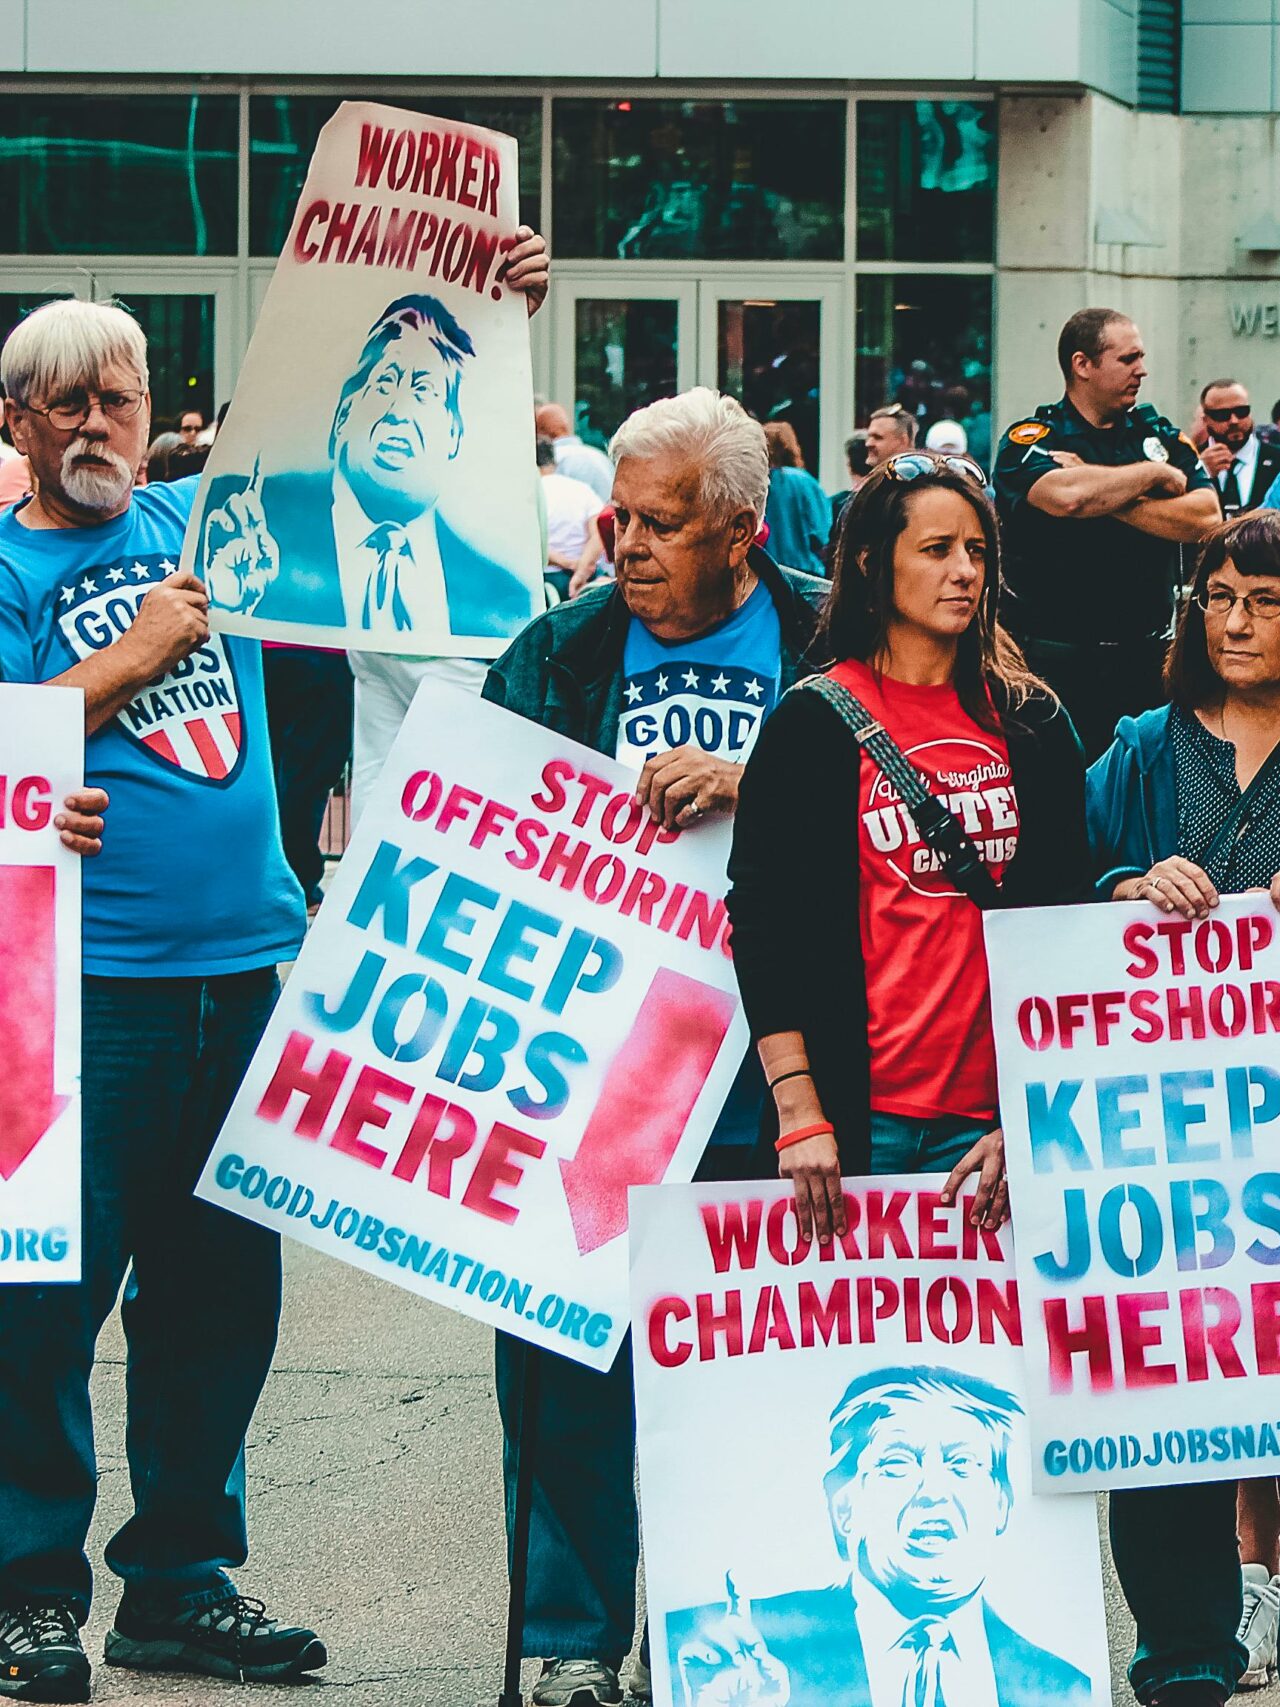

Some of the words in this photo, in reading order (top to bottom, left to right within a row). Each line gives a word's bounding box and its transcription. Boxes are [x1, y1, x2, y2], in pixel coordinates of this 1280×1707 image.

[355, 122, 502, 218] WORKER
[74, 594, 147, 651] GO
[124, 677, 234, 732] NATION
[625, 704, 757, 752] GOOD
[400, 768, 734, 961] OFFSHORIN
[346, 839, 625, 1017] KEEP
[1122, 914, 1275, 980] STOP
[300, 949, 591, 1121] JOBS
[254, 1029, 548, 1227] HERE
[214, 1153, 613, 1350] GOODJOBSNATION.ORG
[646, 1276, 1024, 1369] CHAMPION
